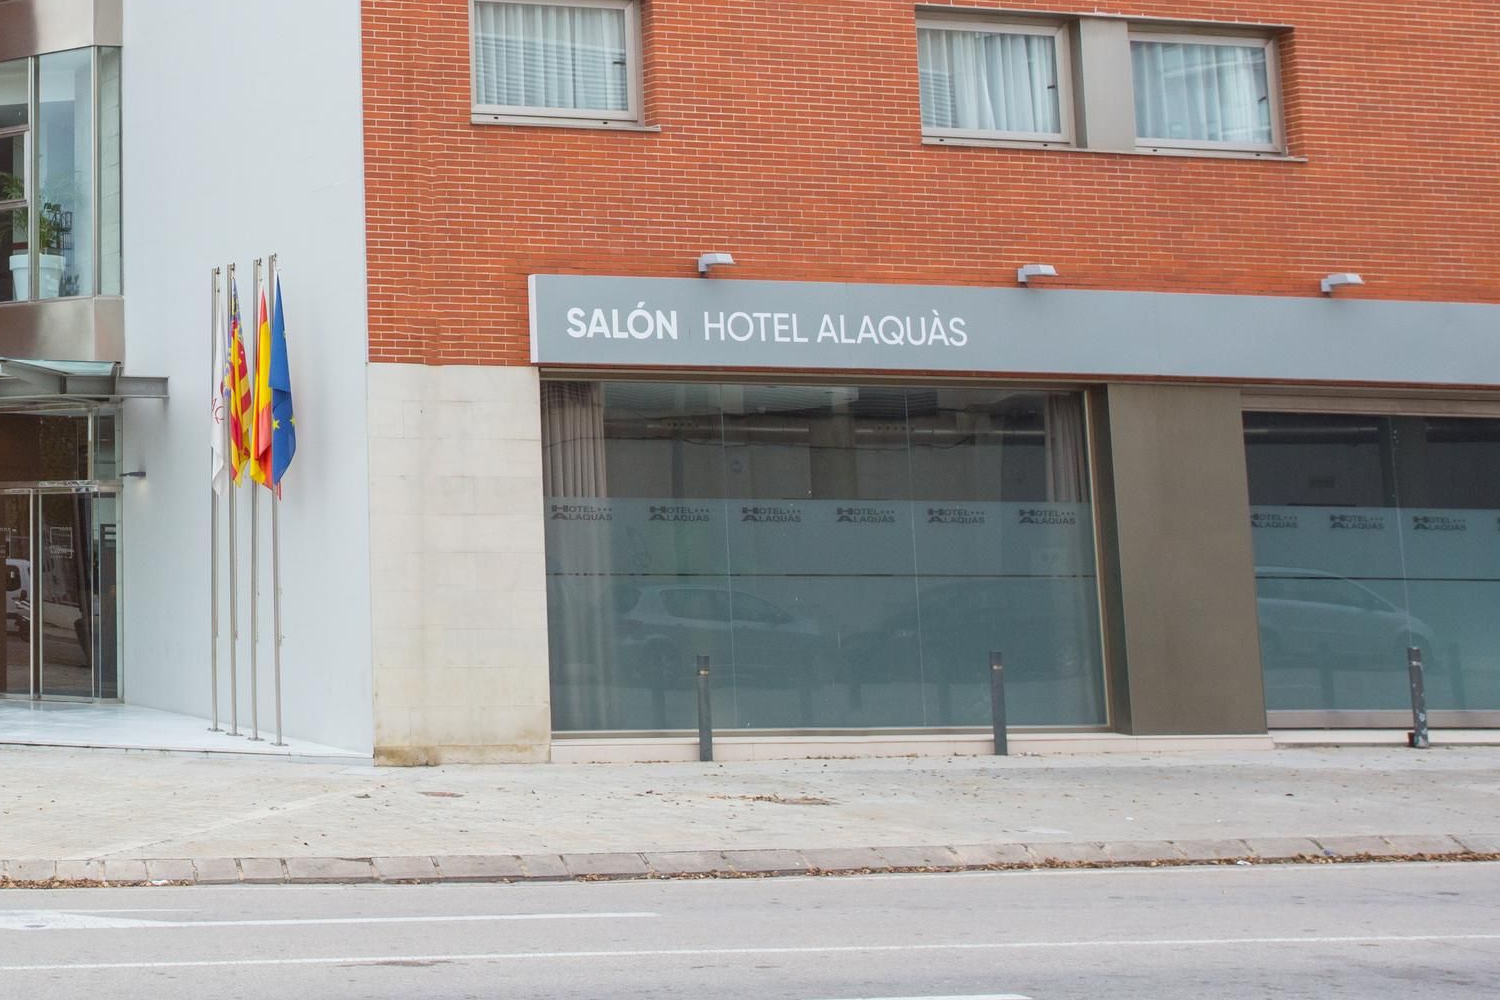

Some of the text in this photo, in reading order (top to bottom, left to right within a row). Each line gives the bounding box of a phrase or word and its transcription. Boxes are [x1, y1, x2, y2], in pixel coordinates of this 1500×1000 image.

[565, 300, 969, 347] SALÓN HOTEL ALAQUÀS
[551, 504, 597, 513] HOTEL
[649, 506, 694, 514] HOTEL
[741, 507, 786, 515] HOTEL
[836, 507, 880, 515] HOTEL
[927, 508, 971, 516] HOTEL
[1019, 509, 1061, 517] HOTEL
